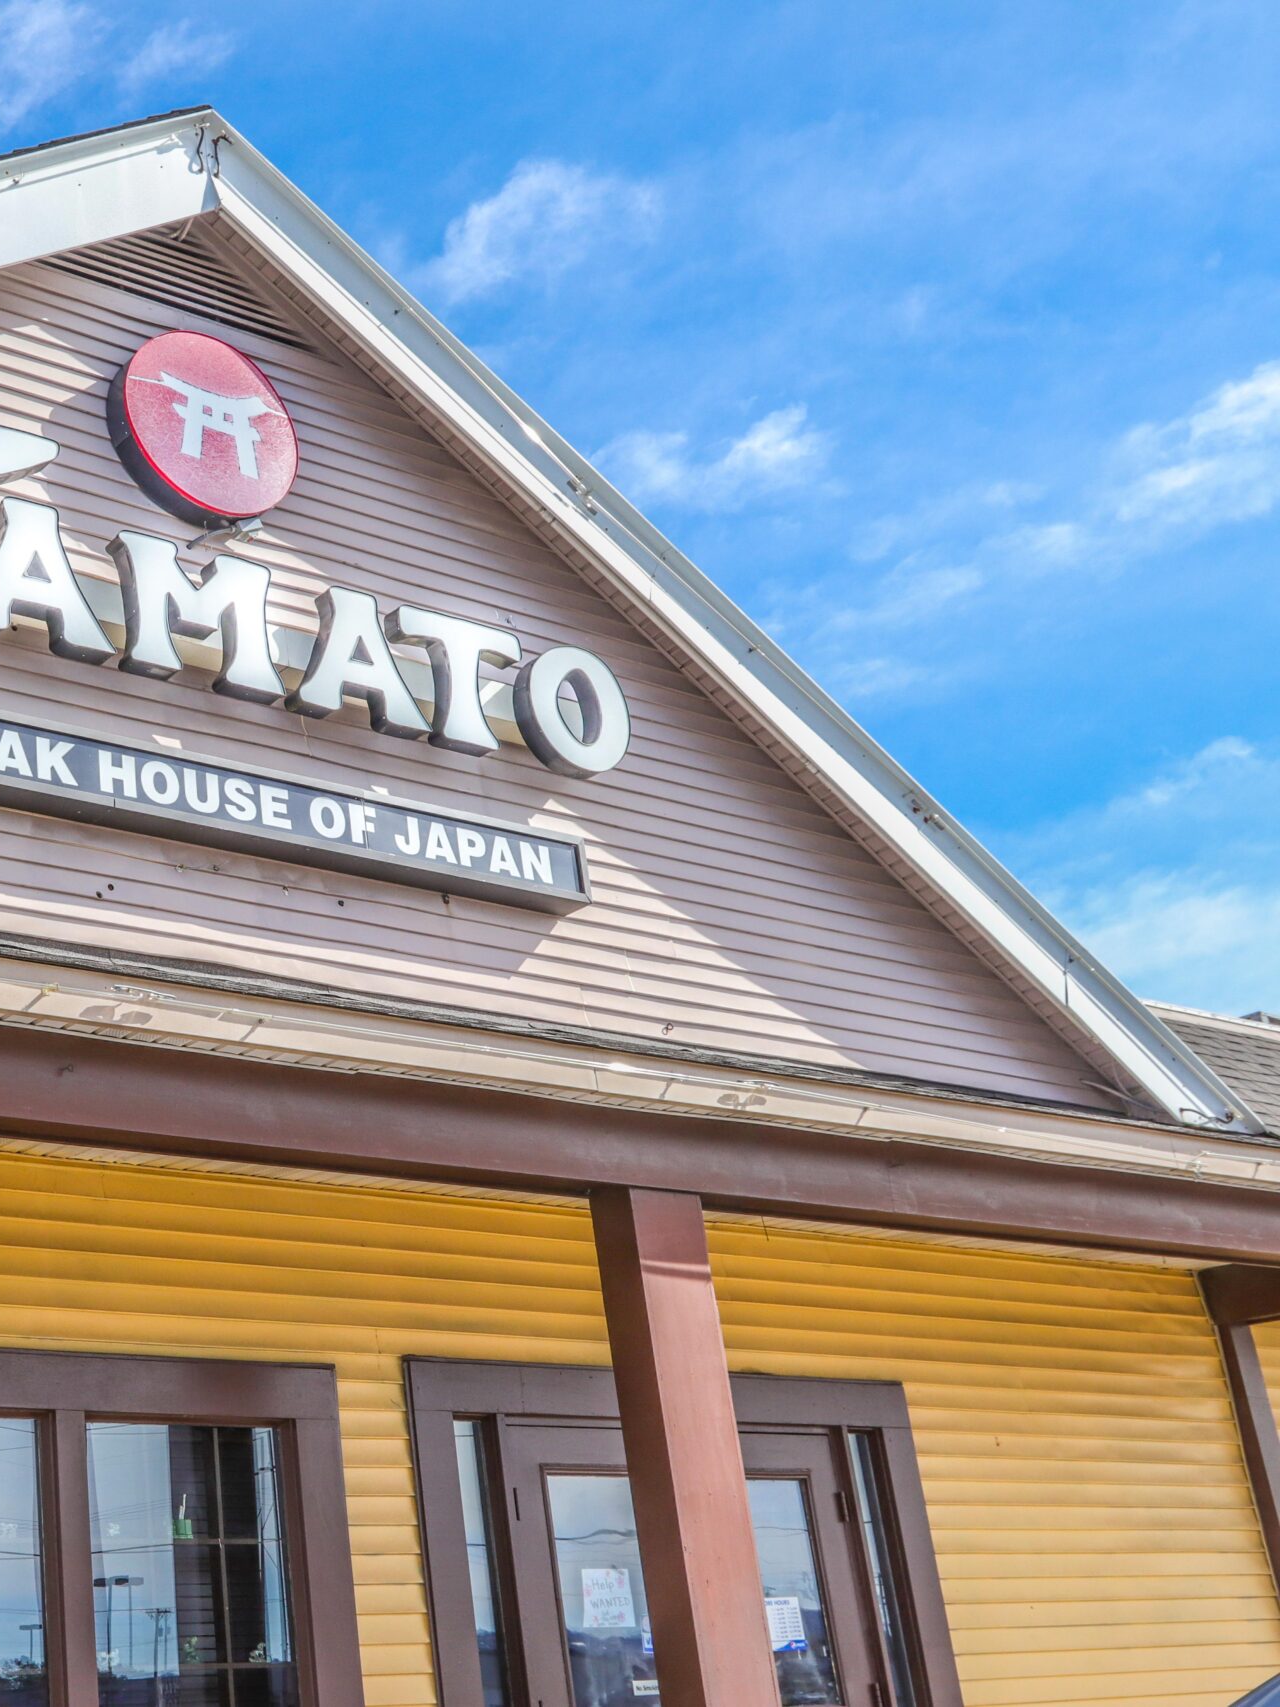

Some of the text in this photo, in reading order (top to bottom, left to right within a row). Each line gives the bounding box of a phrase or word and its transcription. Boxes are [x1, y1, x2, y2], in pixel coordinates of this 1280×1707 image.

[99, 751, 292, 831] HOUSE
[310, 796, 378, 845] OF
[395, 815, 554, 885] JAPAN
